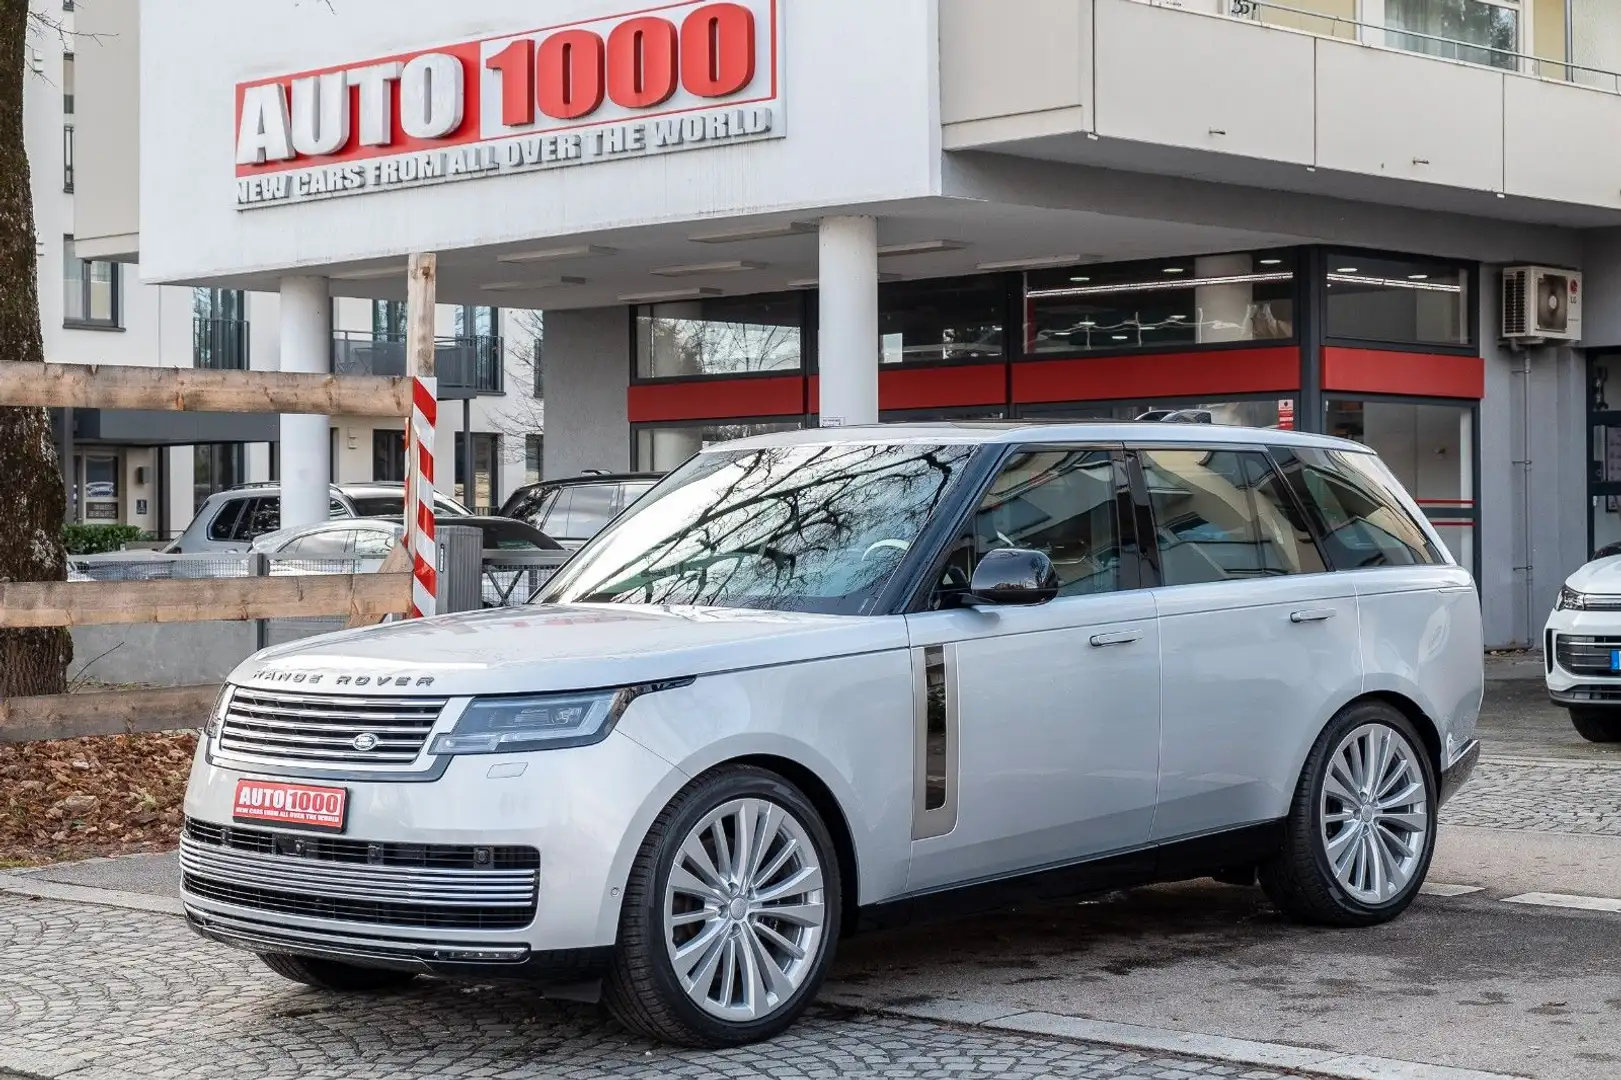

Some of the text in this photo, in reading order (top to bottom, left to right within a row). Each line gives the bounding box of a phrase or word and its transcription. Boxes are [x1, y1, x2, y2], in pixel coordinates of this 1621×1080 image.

[236, 2, 755, 165] AUTO 1000
[236, 107, 772, 204] NEW CARS FROM ALL OVER THE WORLD
[335, 675, 435, 687] ROVER
[238, 786, 339, 814] AUTO 1000
[279, 810, 289, 818] ALL
